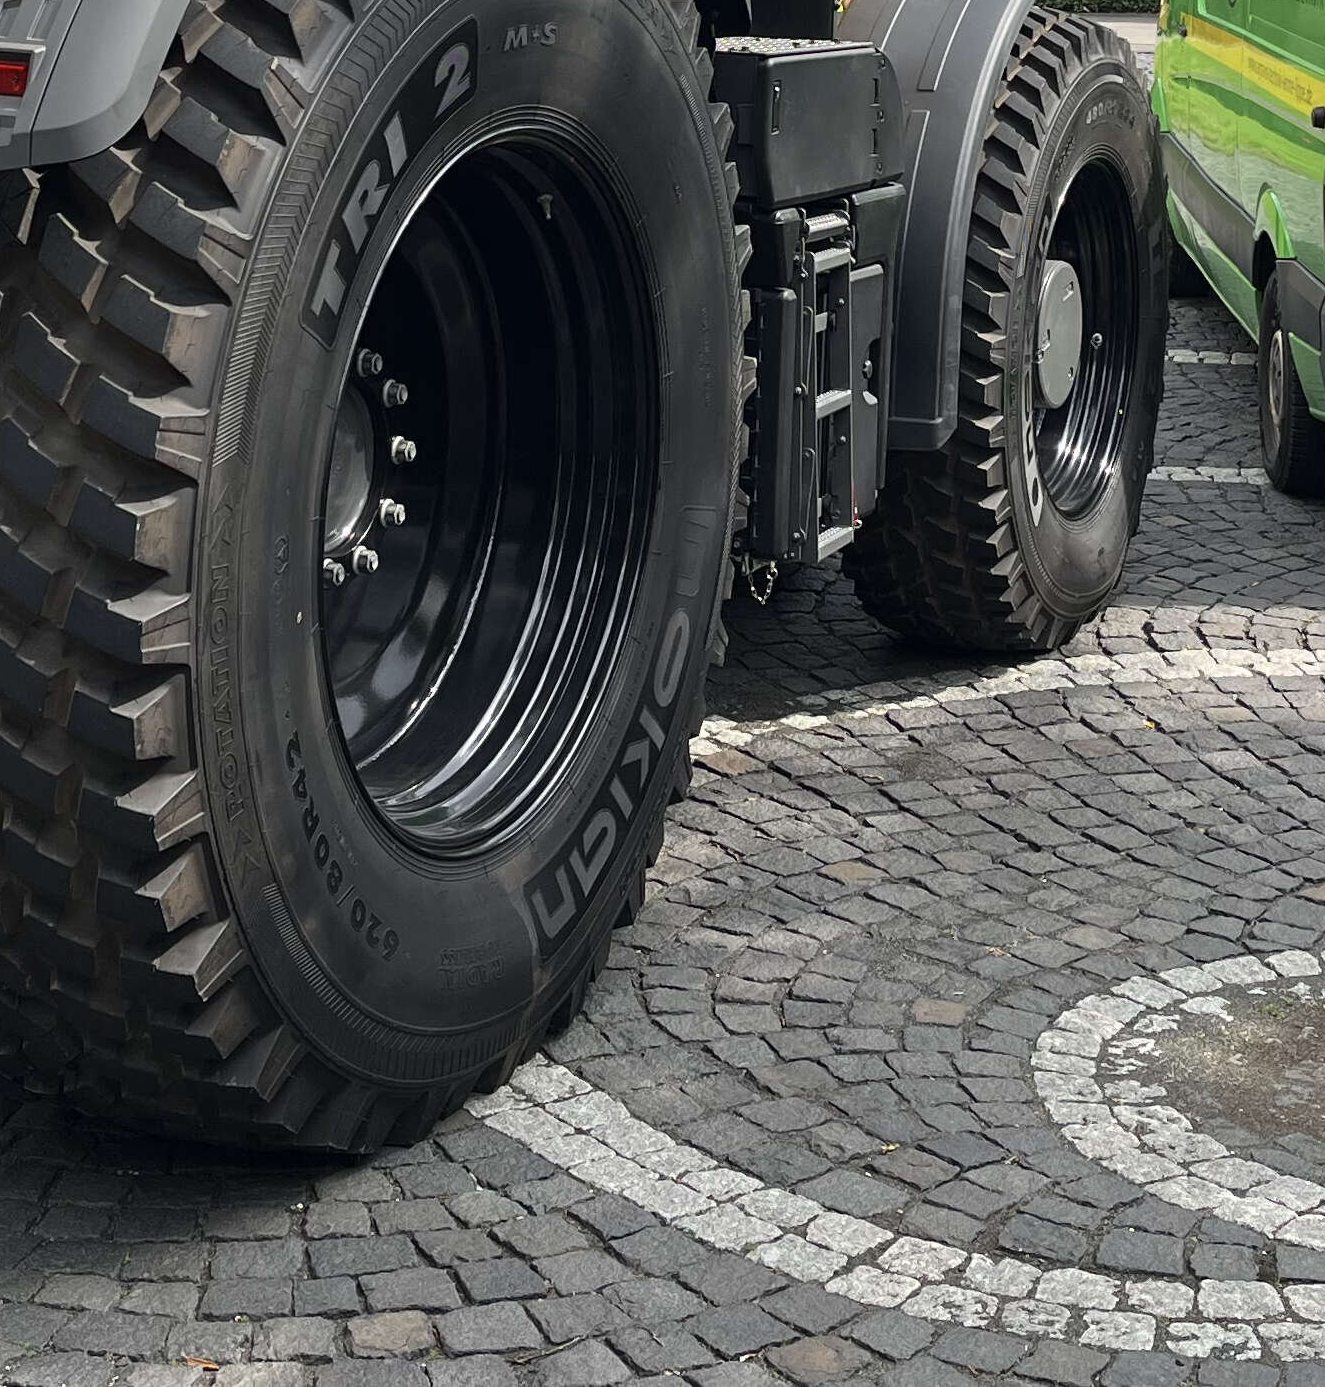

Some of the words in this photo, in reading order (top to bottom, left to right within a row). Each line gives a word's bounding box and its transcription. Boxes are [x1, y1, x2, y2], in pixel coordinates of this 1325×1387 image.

[503, 21, 559, 52] M+S
[310, 110, 409, 316] TRI
[433, 43, 471, 121] 2
